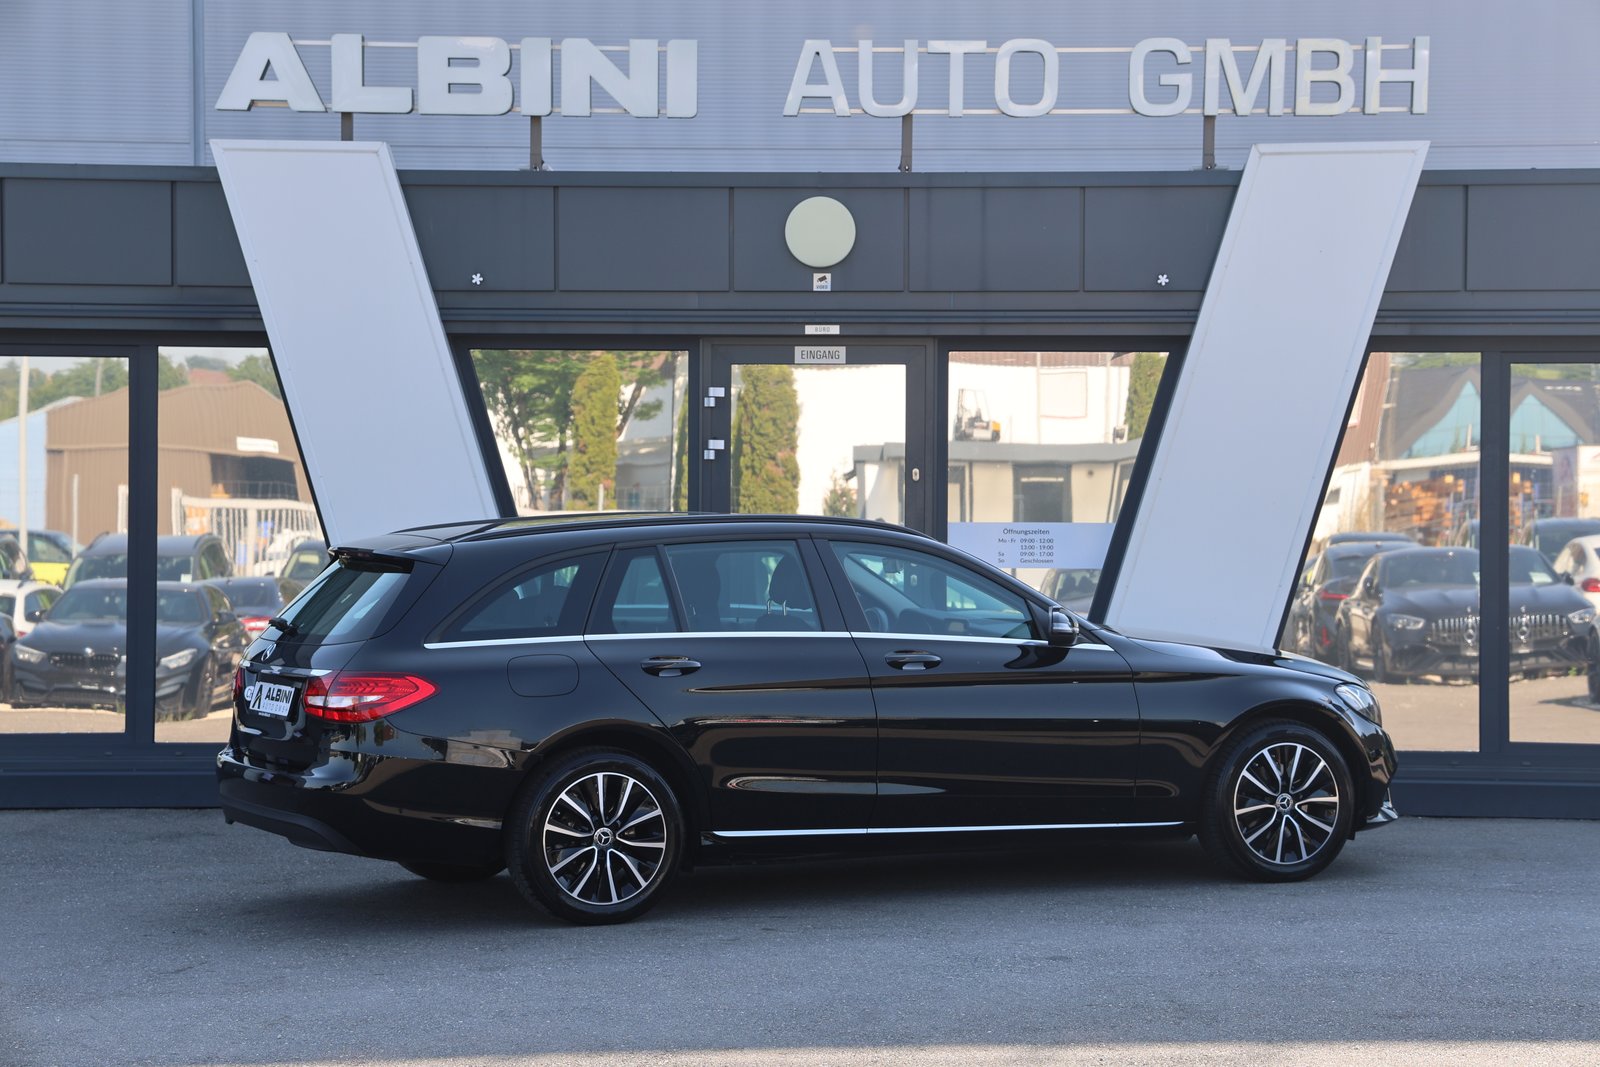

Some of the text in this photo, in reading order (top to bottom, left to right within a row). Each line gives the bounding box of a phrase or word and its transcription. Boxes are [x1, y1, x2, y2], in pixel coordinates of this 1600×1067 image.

[215, 32, 1431, 118] ALBINI AUTO GMBH
[800, 350, 841, 360] EINGANG
[265, 687, 292, 704] ALBINI
